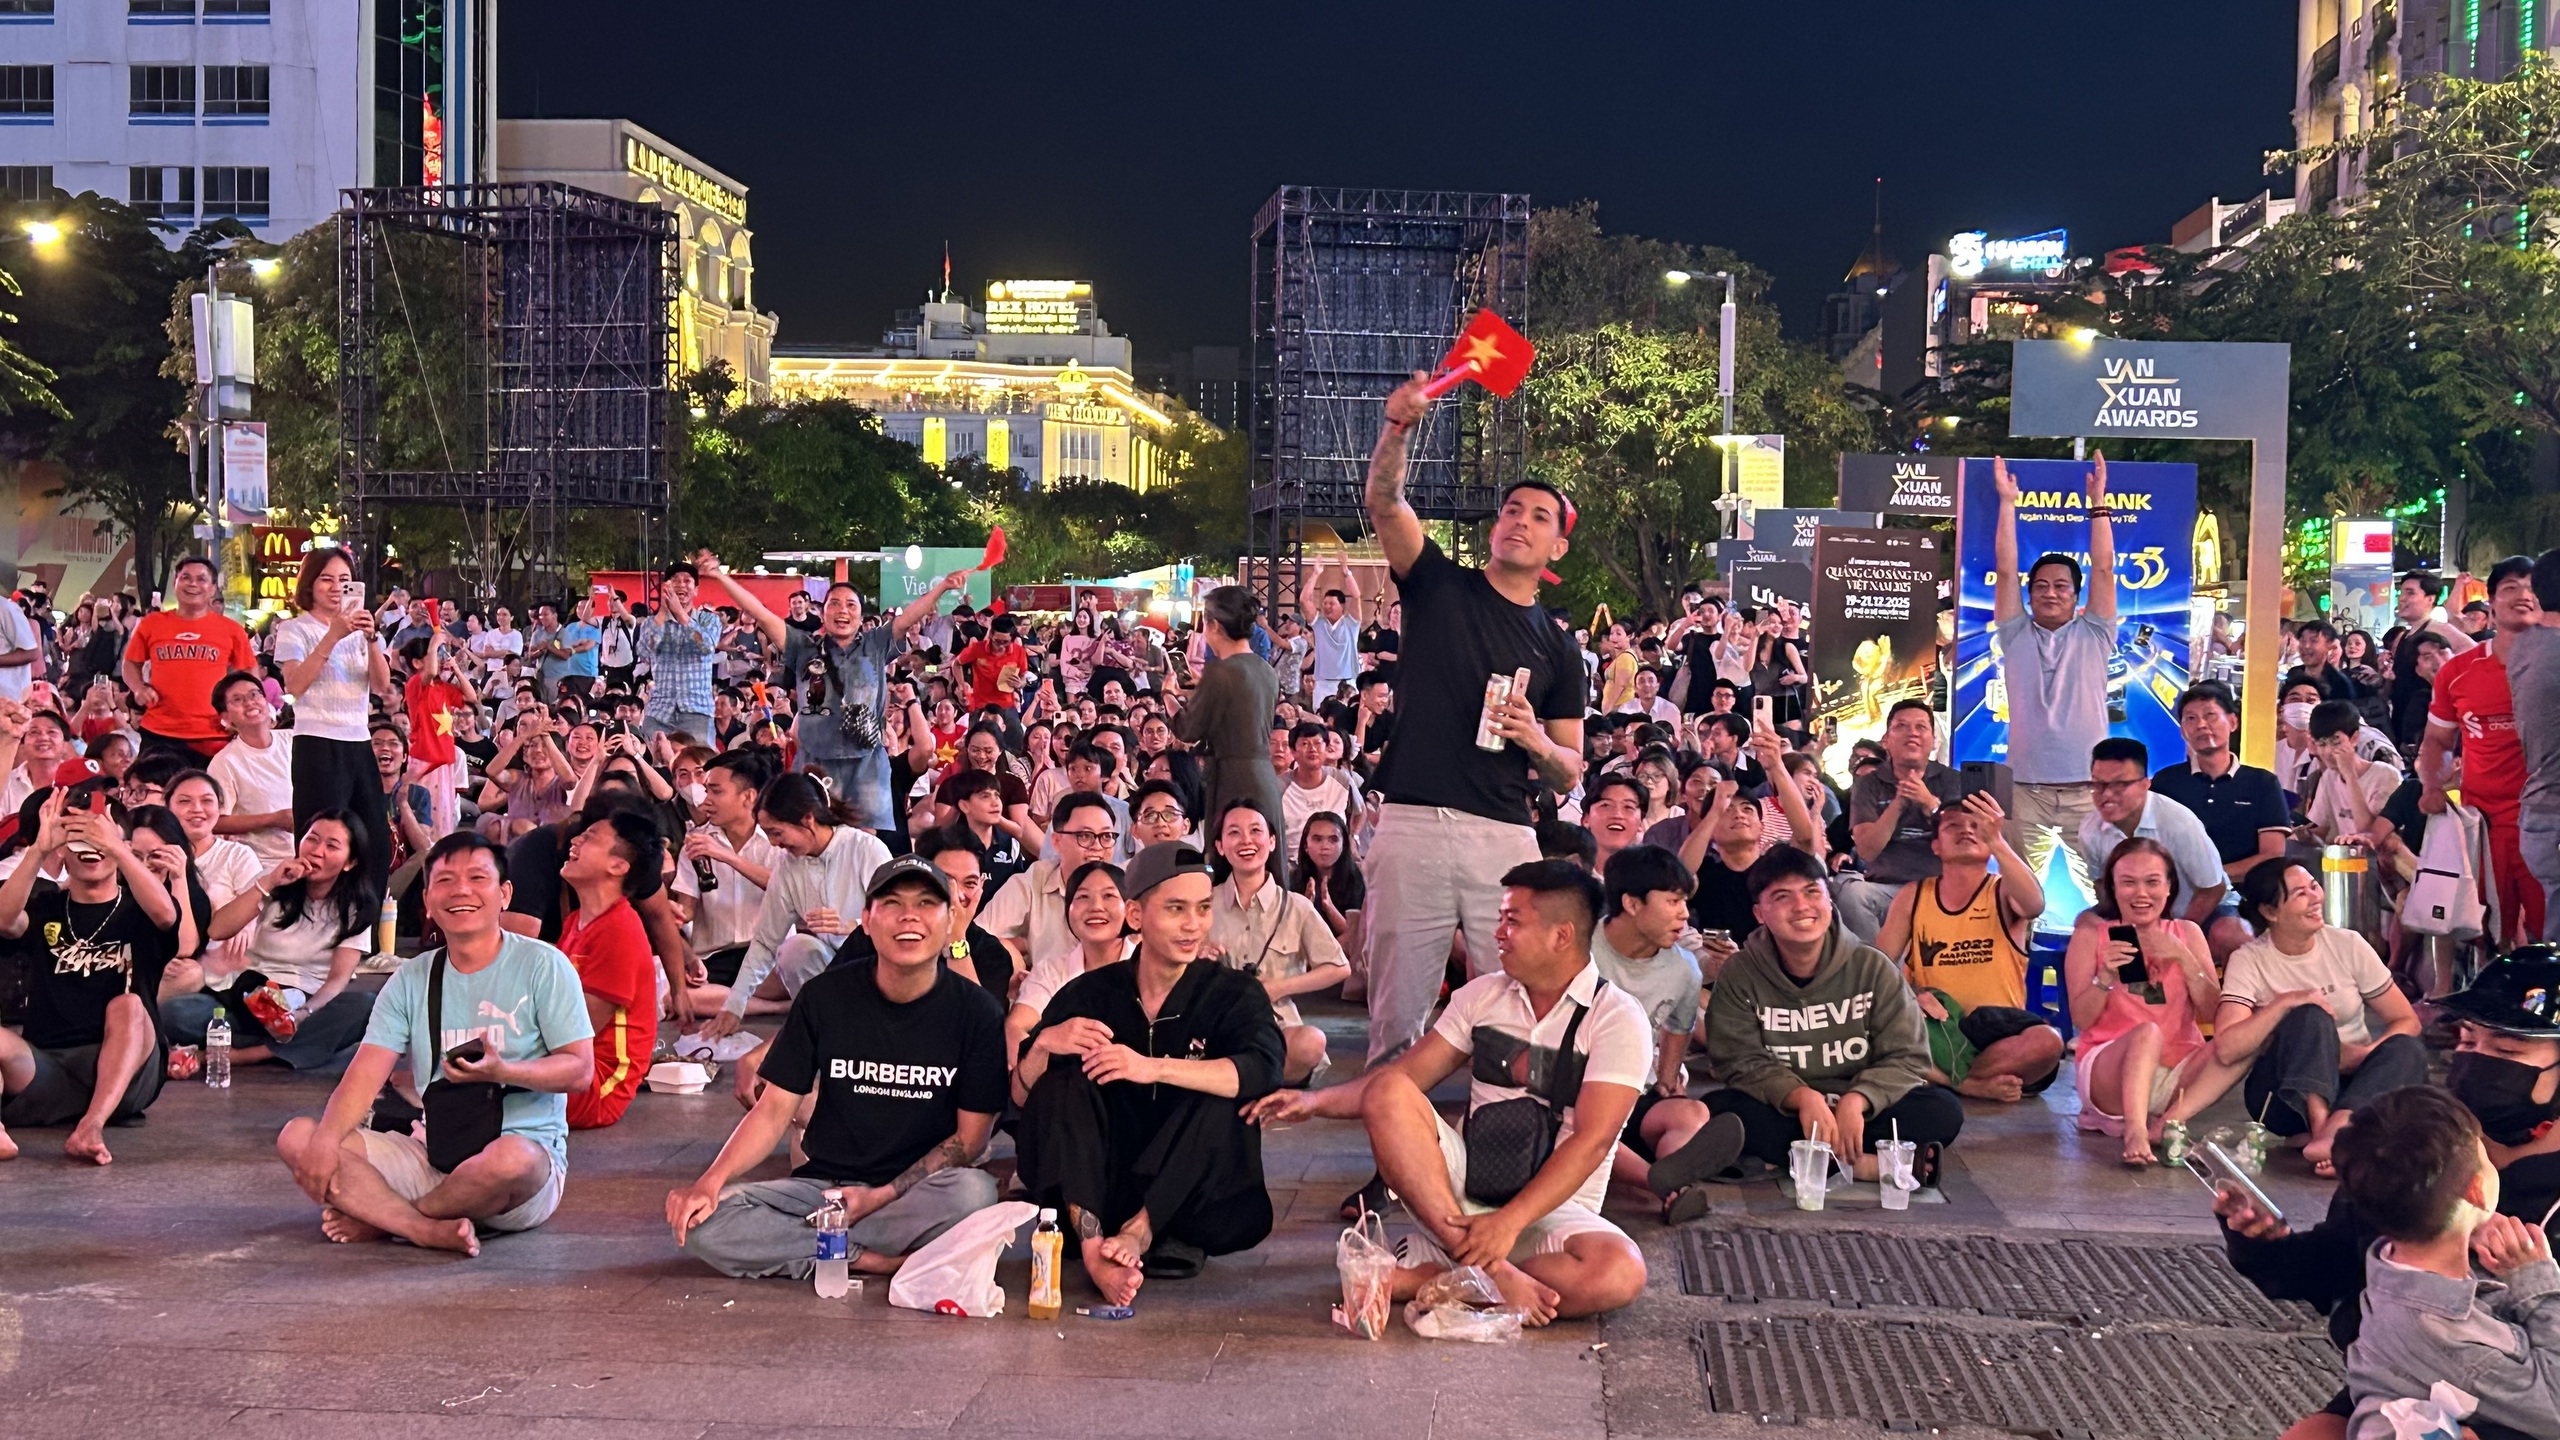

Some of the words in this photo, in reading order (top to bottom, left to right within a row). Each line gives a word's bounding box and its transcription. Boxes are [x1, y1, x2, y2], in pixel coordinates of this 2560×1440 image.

[986, 301, 1022, 313] REX
[1025, 301, 1079, 314] HOTEL
[2104, 358, 2154, 380] VAN
[2101, 387, 2181, 408] XUAN
[2094, 409, 2199, 428] AWARDS
[1896, 463, 1926, 477] VAN
[1895, 481, 1941, 494] XUAN
[1889, 494, 1951, 507] AWARDS
[2064, 492, 2082, 508] A
[156, 644, 219, 663] GIANTS
[830, 1058, 958, 1087] BURBERRY
[853, 1084, 890, 1096] LONDON
[891, 1089, 933, 1100] ENGLAND
